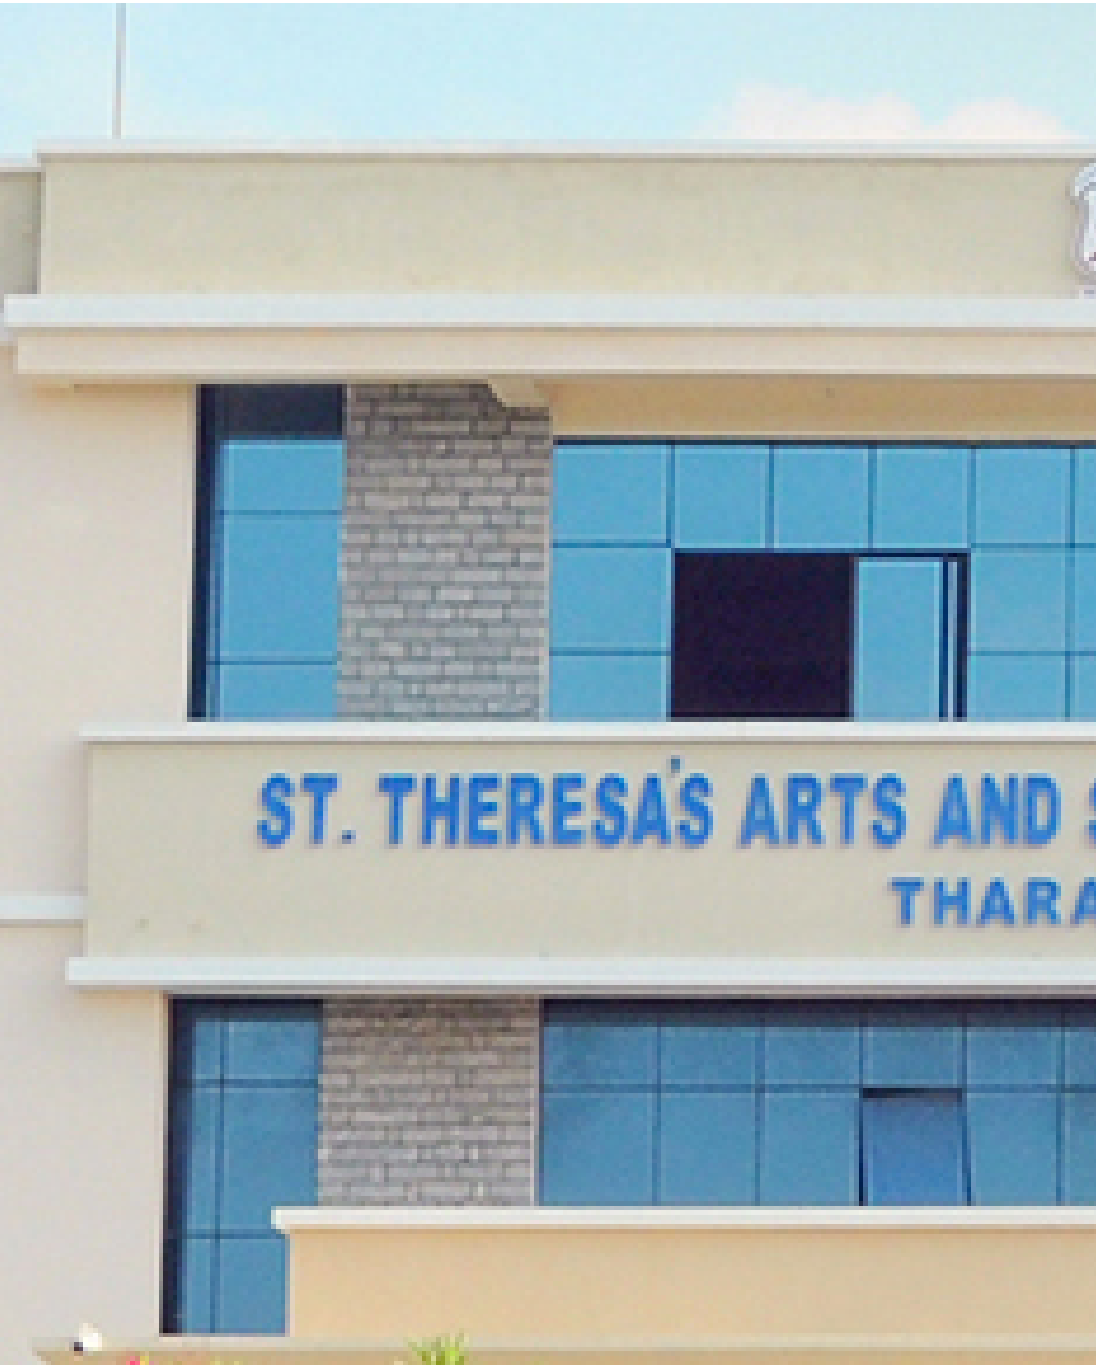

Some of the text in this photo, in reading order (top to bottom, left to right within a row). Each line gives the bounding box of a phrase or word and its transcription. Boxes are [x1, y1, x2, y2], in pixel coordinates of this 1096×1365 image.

[256, 773, 357, 846] ST.
[378, 756, 713, 846] THERESA'S
[740, 773, 907, 846] ARTS
[933, 773, 1062, 846] AND
